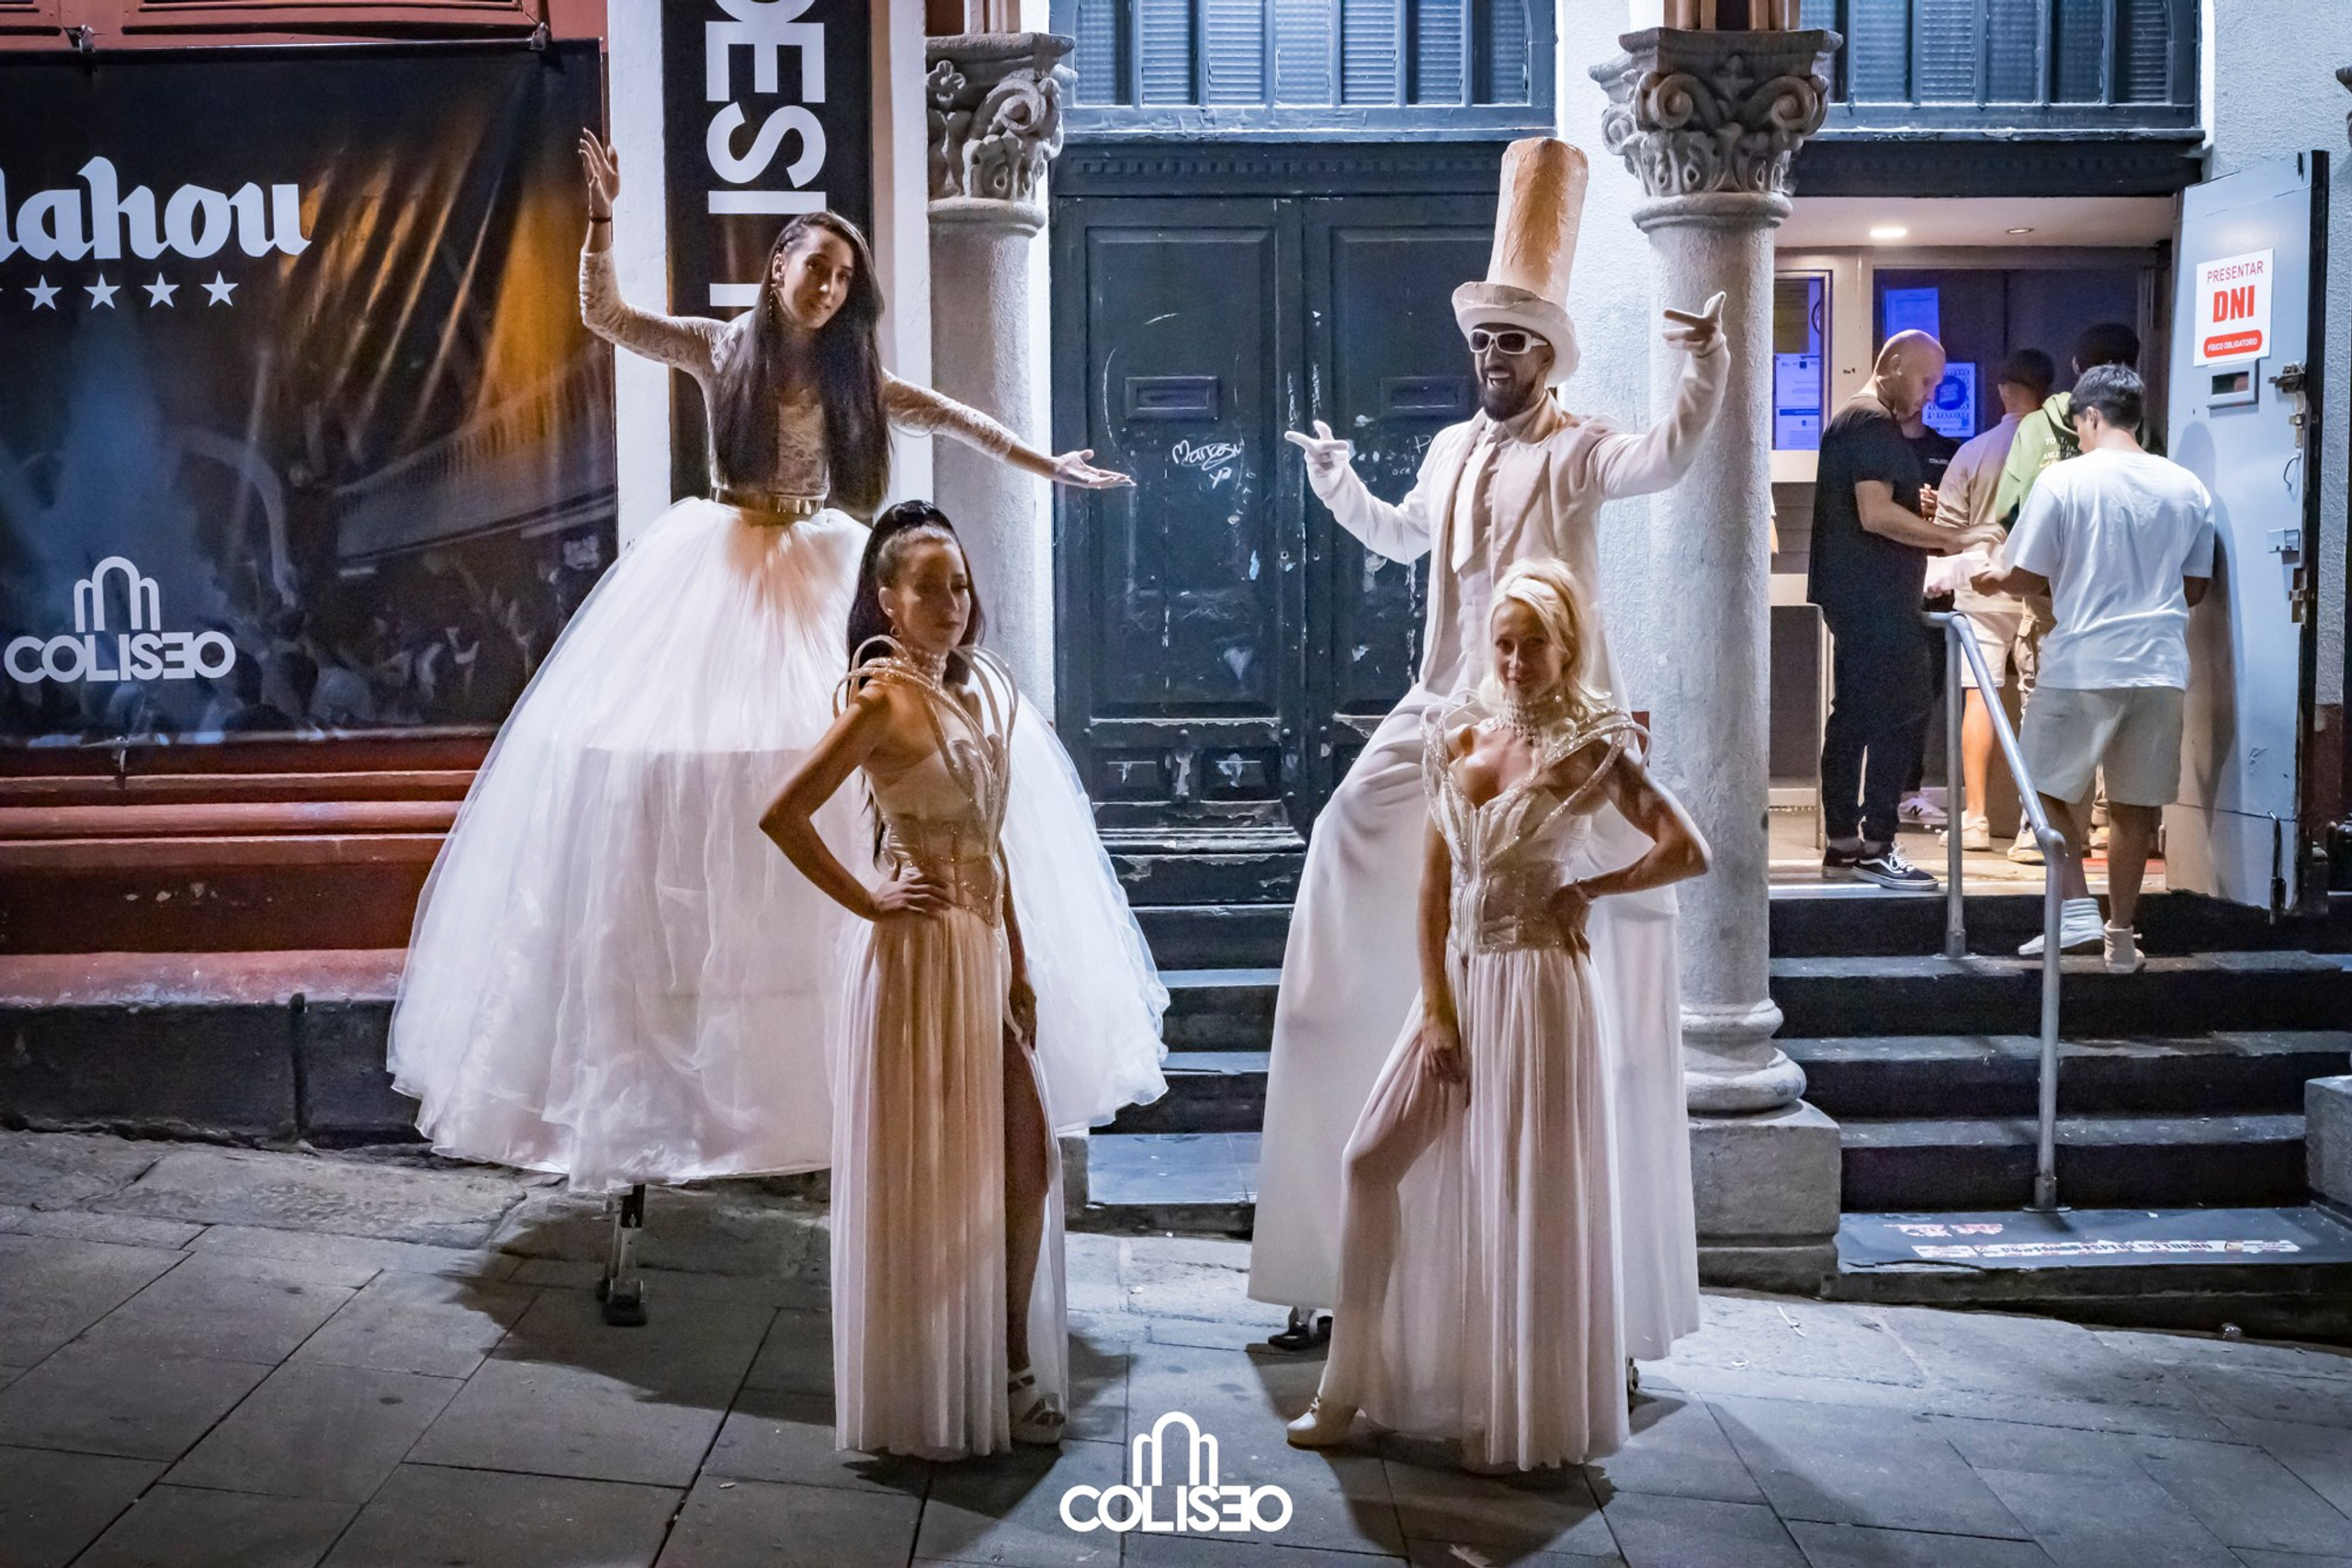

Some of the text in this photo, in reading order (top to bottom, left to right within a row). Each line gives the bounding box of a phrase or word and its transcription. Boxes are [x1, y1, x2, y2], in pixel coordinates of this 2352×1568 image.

[0, 155, 312, 262] ahou
[2207, 261, 2264, 284] PRESENTAR
[2212, 285, 2256, 323] DNI
[2223, 337, 2258, 349] OBLIGATORIO
[4, 630, 236, 683] COLISEO
